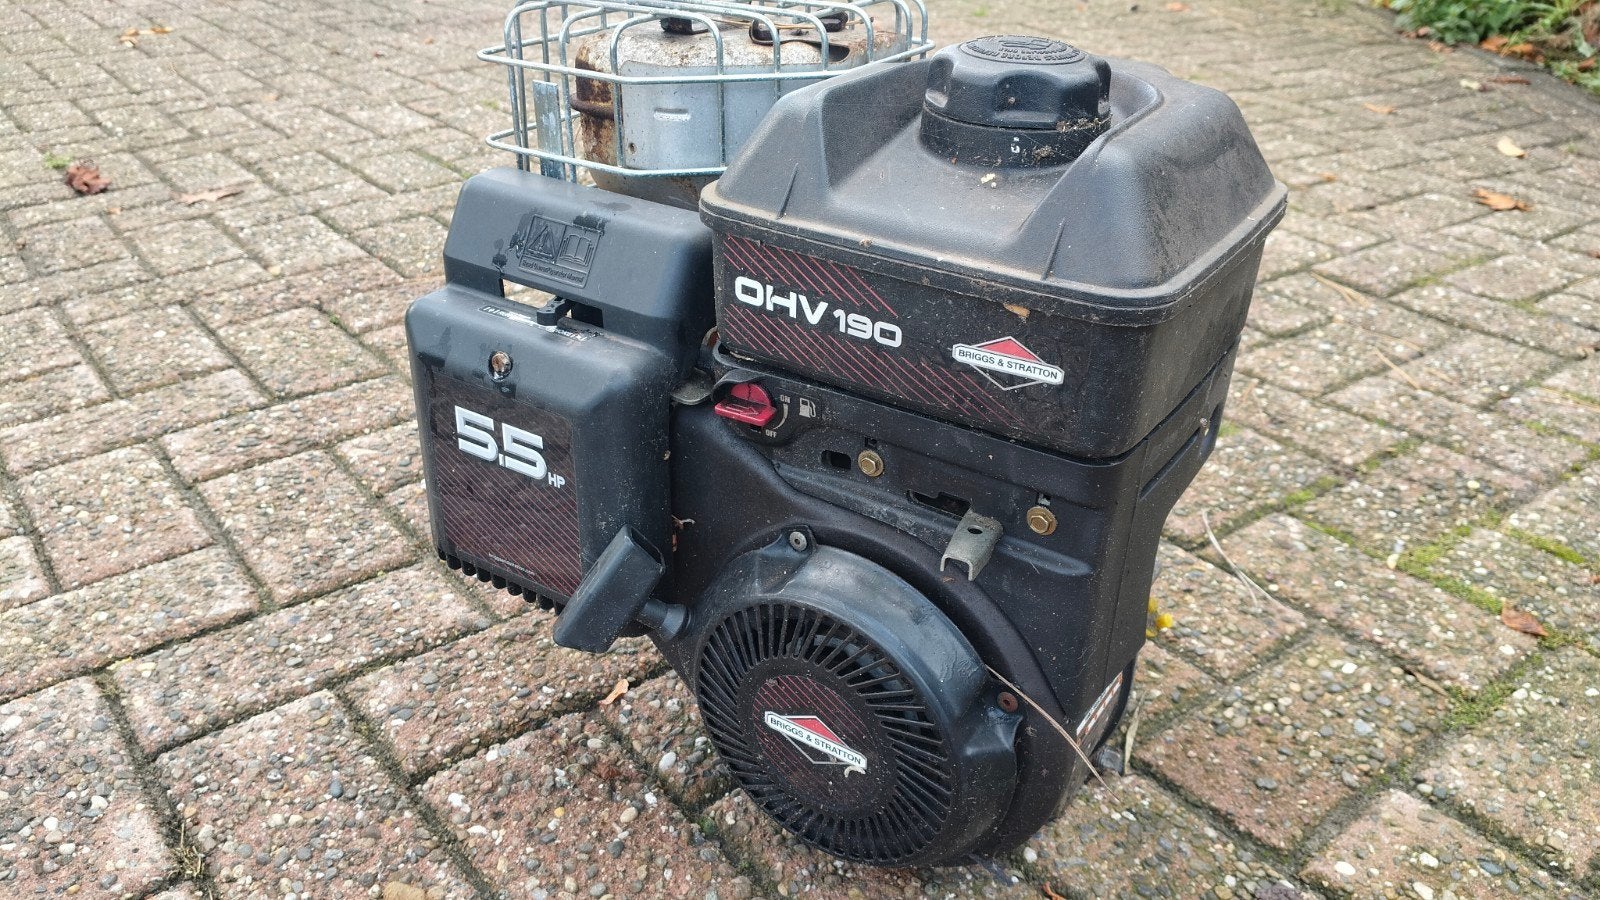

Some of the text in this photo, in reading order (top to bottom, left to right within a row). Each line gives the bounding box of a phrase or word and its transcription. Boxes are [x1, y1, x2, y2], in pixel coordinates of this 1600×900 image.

[734, 275, 903, 348] OHV 190
[958, 349, 1058, 380] BRIGGS & STRATTON
[780, 394, 791, 404] ON
[455, 405, 566, 489] 5.5 HP
[765, 428, 777, 438] OFF
[770, 717, 861, 765] BRIGGS & STRATTON
